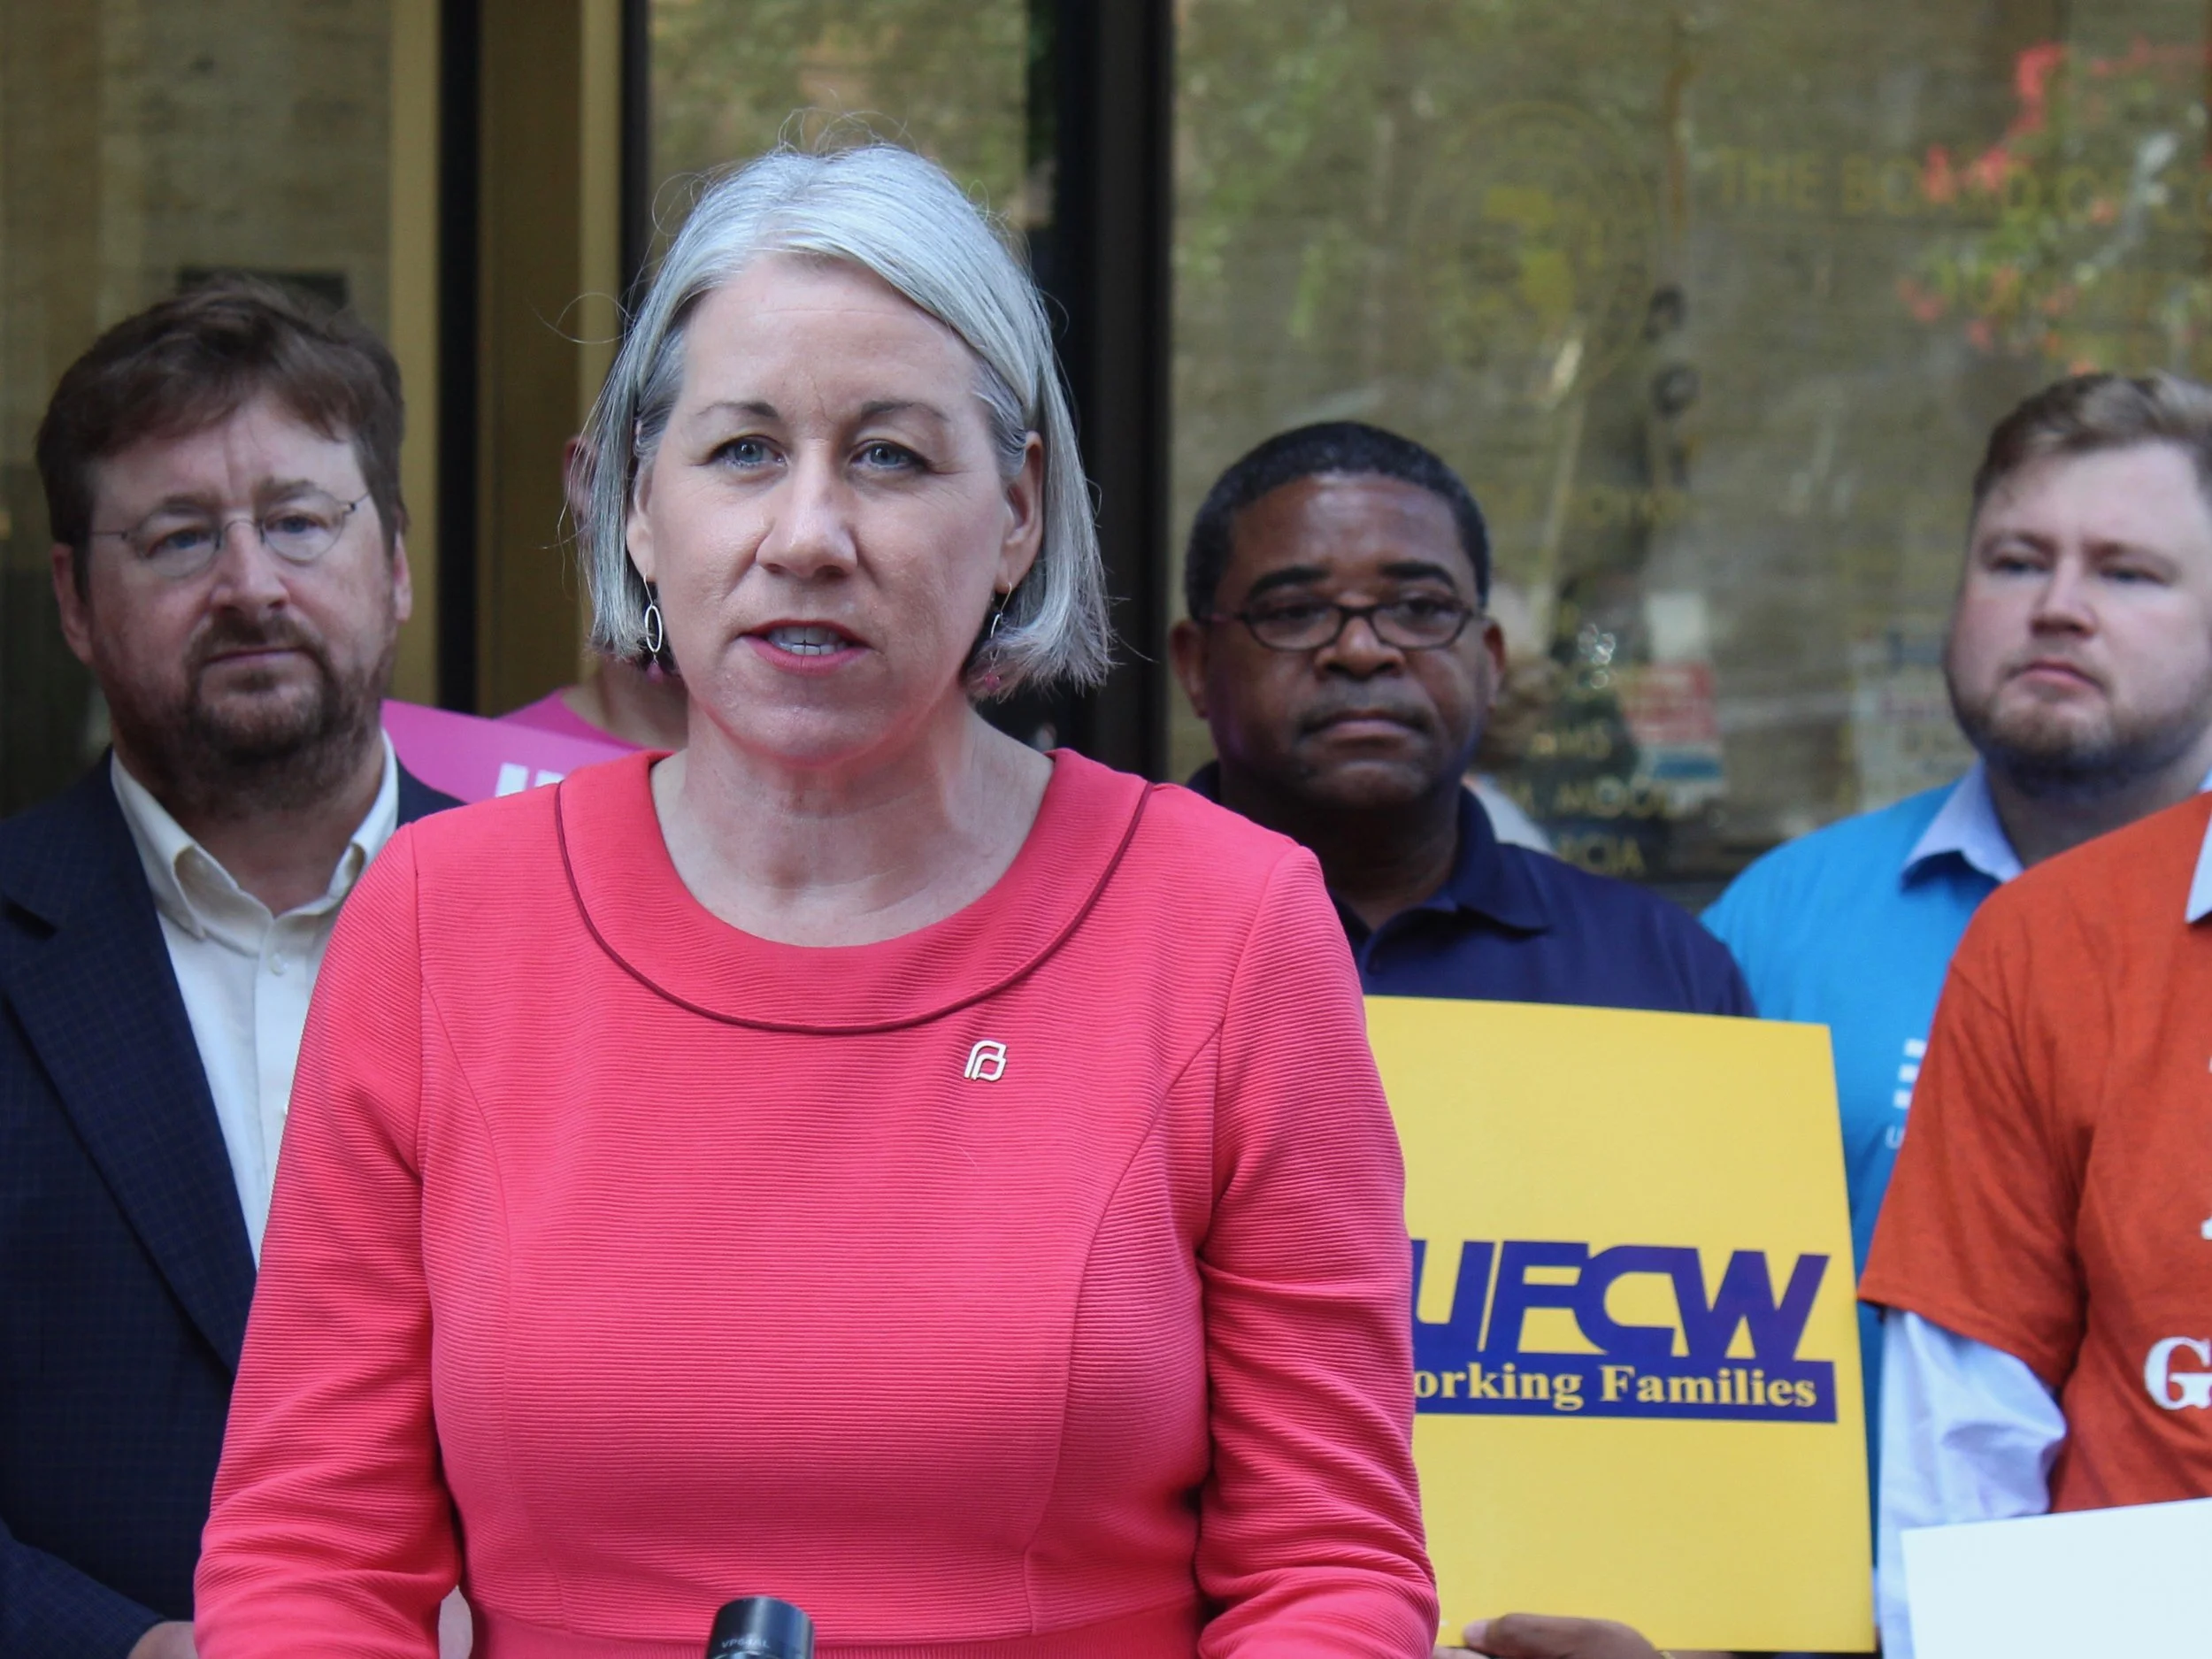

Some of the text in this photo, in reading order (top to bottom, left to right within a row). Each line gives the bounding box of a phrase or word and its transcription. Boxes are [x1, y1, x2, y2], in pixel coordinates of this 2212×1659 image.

[1410, 1240, 1831, 1363] UFCW
[1414, 1362, 1817, 1411] orking Families
